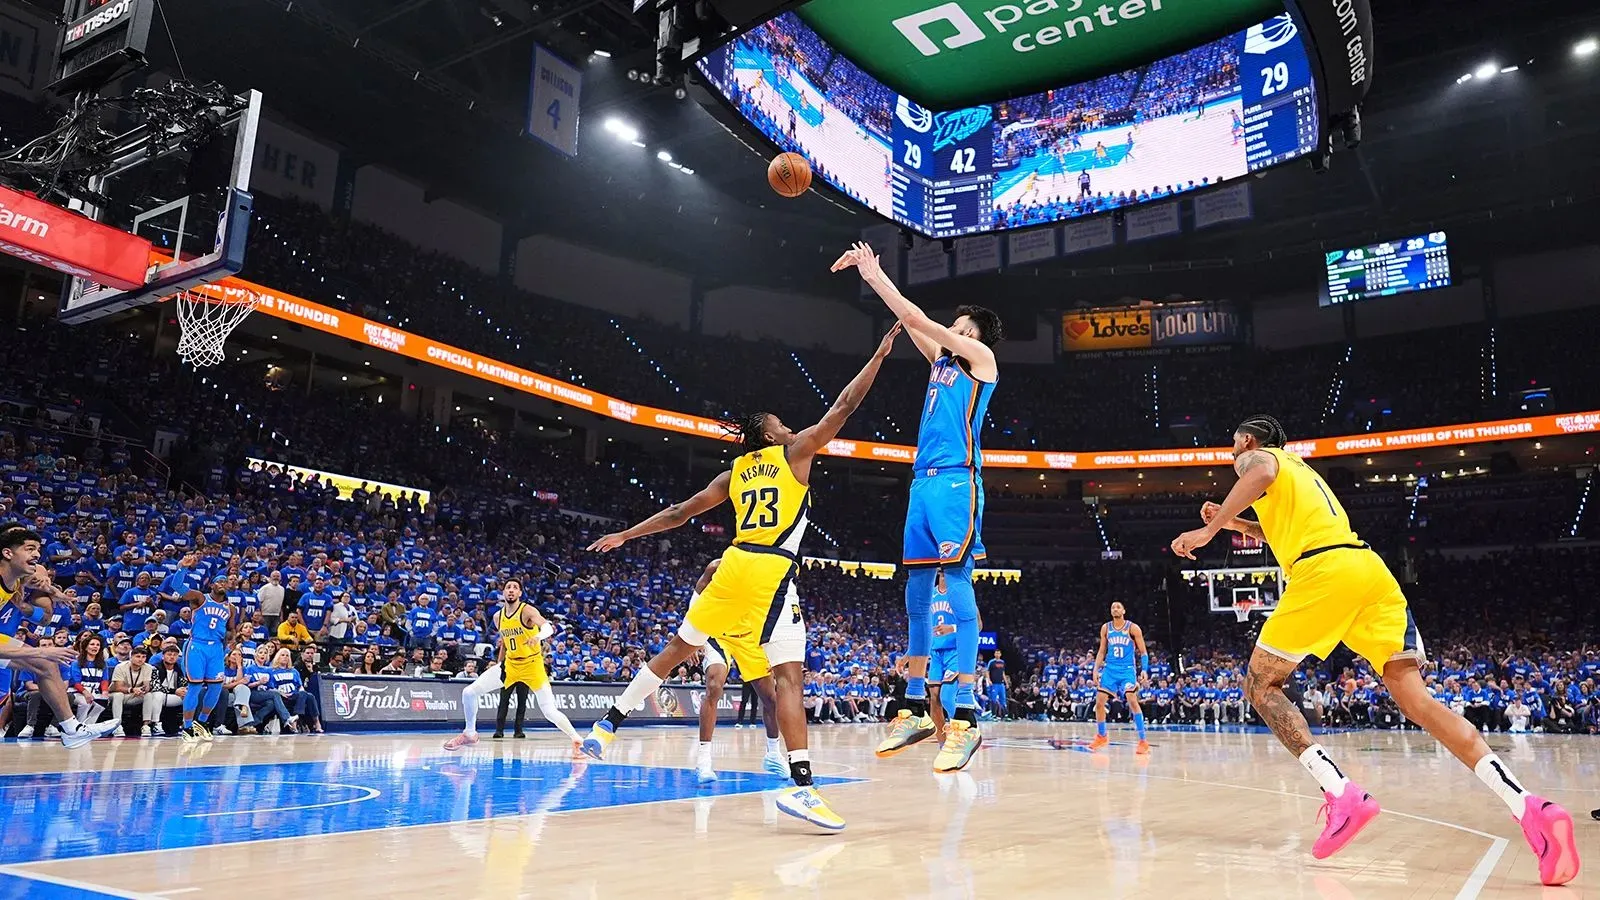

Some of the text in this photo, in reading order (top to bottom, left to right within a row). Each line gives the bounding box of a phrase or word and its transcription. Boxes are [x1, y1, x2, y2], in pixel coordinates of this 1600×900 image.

[84, 0, 132, 35] TISSOT
[1346, 35, 1367, 86] center
[1260, 61, 1289, 96] 29
[547, 99, 561, 130] 4
[904, 139, 922, 169] 29
[950, 148, 976, 174] 42
[277, 298, 339, 328] THUNDER
[1202, 310, 1239, 336] CITY
[363, 323, 406, 346] POST OAK
[368, 336, 399, 352] TOYOTA
[427, 346, 593, 406] OFFICIAL PARTNER OF THE THUNDER
[929, 387, 938, 413] 7
[655, 414, 695, 430] OFFICIAL
[1556, 413, 1600, 428] POST OAK
[1563, 422, 1595, 433] TOYOTA
[1336, 422, 1533, 451] OFFICIAL PARTNER OF THE THUNDER
[872, 447, 1028, 463] OFFICIAL THUNDER
[1095, 456, 1136, 465] OFFICIAL
[1138, 453, 1180, 463] PARTNER
[1181, 452, 1194, 462] OF
[1195, 451, 1214, 461] THE
[740, 464, 780, 483] NESMITH
[740, 487, 779, 531] 23
[203, 606, 229, 618] THUNDER
[209, 617, 218, 629] 5
[509, 637, 517, 651] 0
[1113, 646, 1124, 658] 21
[343, 685, 410, 719] Finals
[425, 700, 457, 710] YouTube TV
[479, 694, 535, 709] EDNSY
[569, 695, 576, 709] 3
[579, 695, 615, 709] 8:30PM
